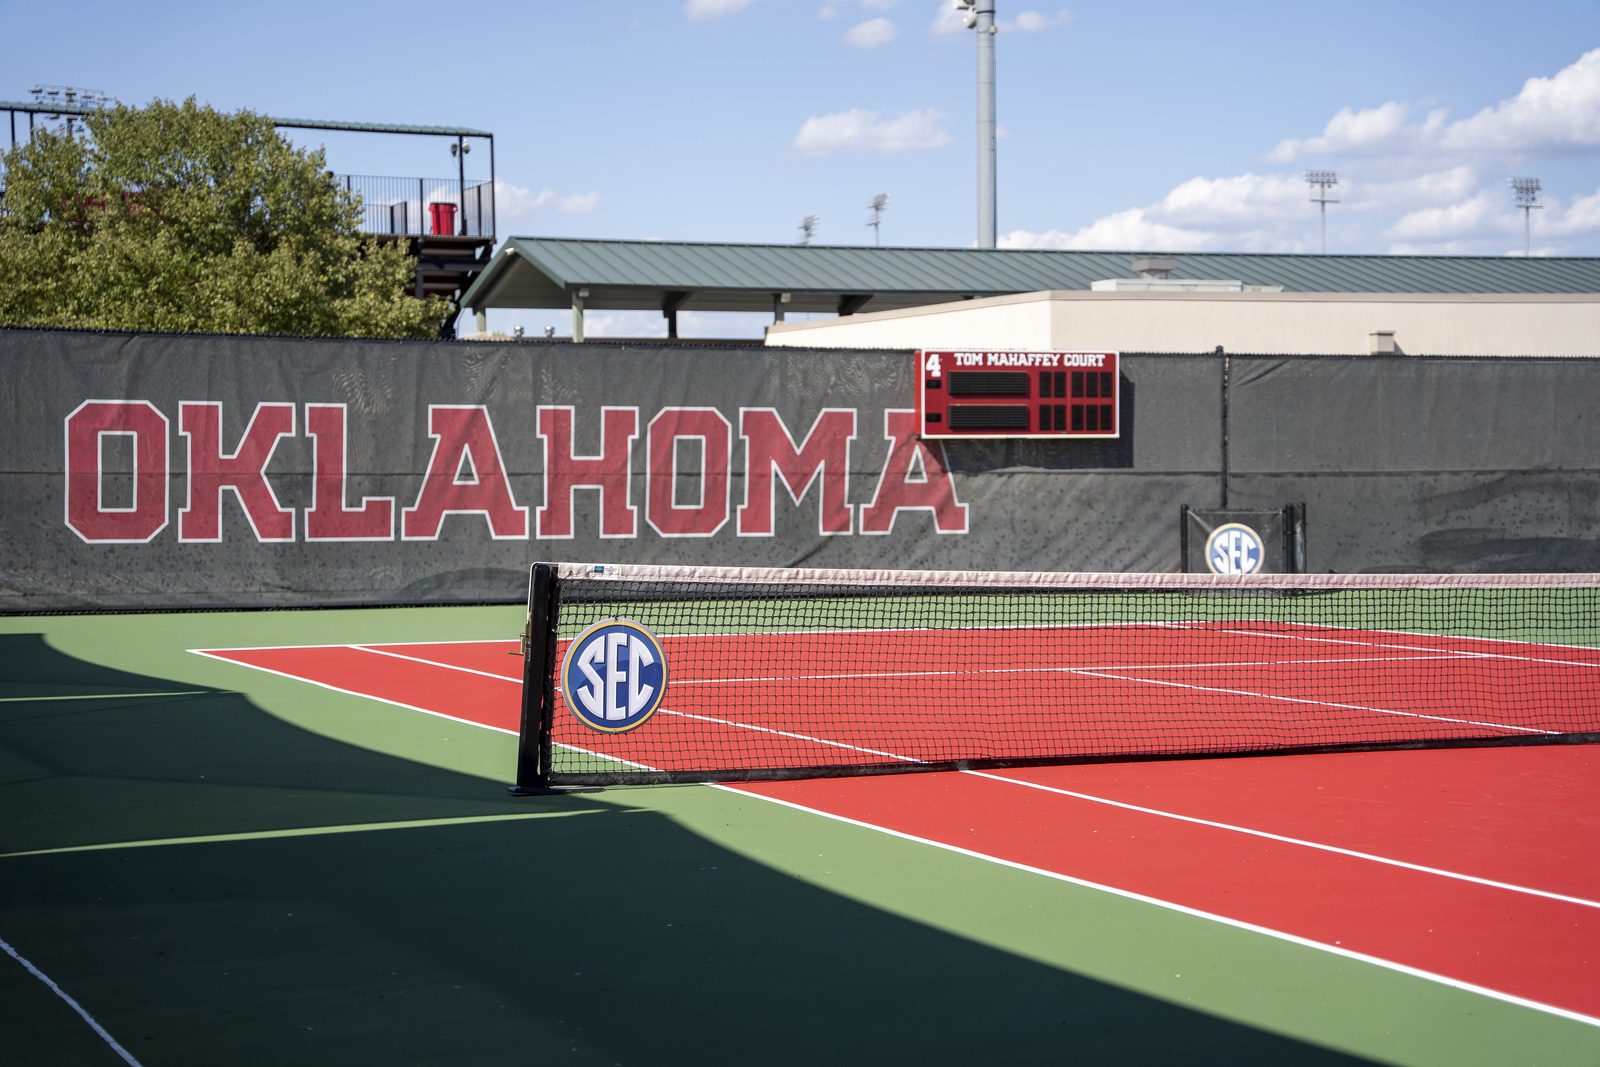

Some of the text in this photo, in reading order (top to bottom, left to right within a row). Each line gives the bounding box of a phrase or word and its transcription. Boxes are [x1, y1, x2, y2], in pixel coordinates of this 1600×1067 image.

[926, 354, 941, 377] 4
[954, 353, 1106, 367] TOM MAHAFFEY COURT
[64, 399, 970, 545] OKLAHOMA
[1213, 530, 1256, 574] SEC
[577, 632, 655, 721] SEC
